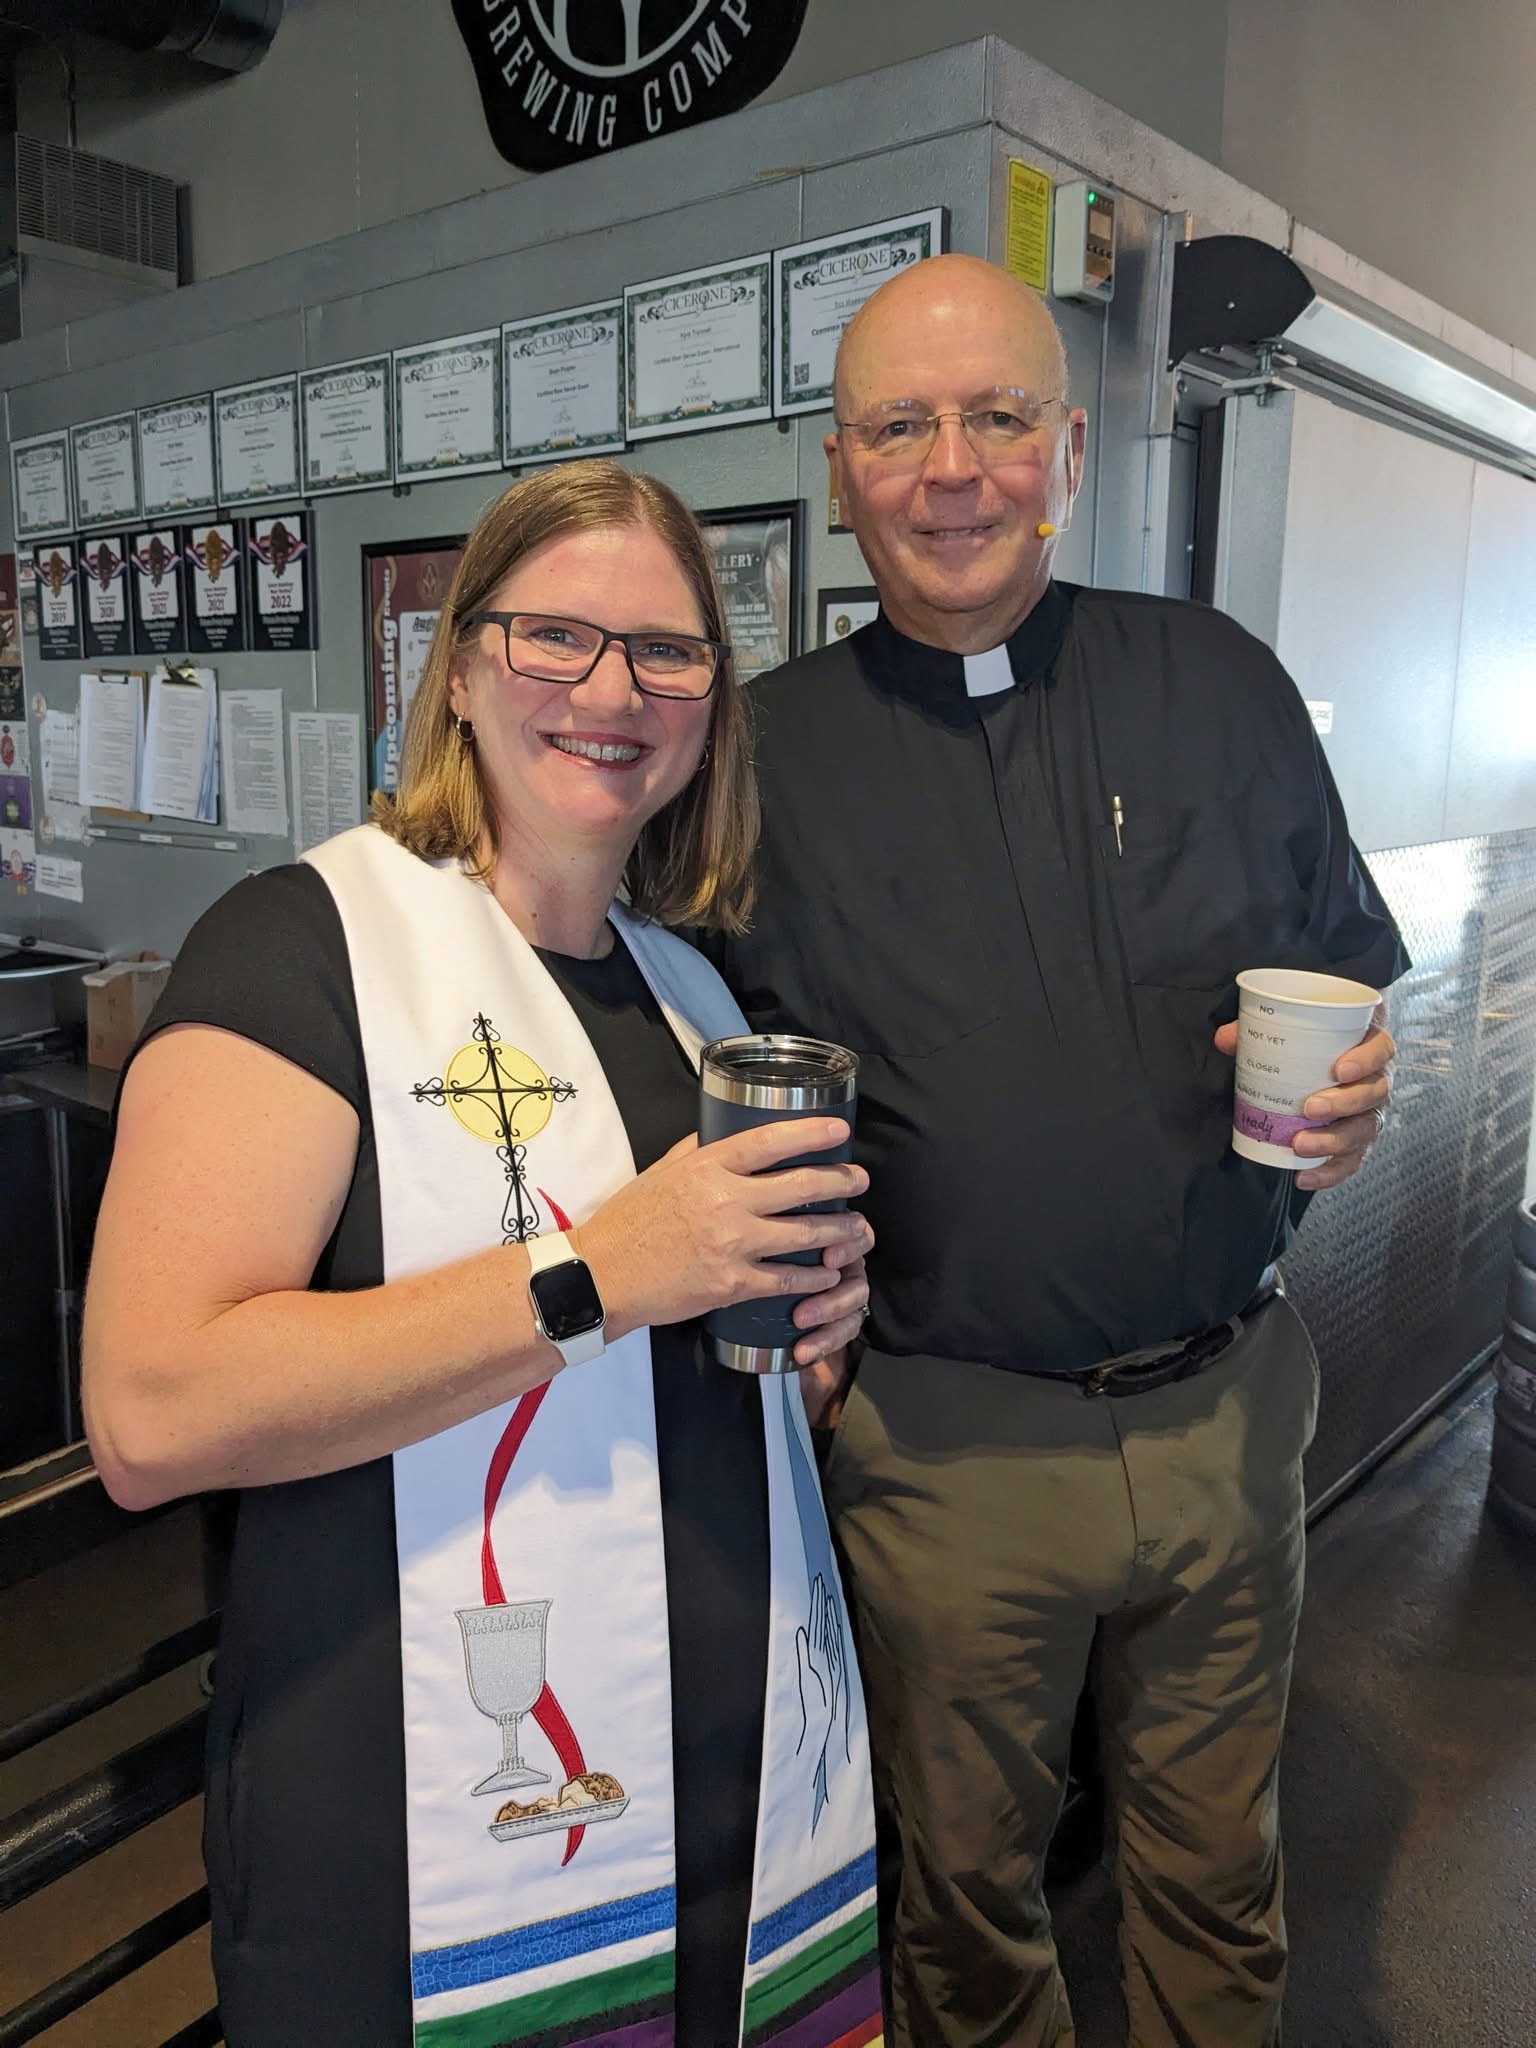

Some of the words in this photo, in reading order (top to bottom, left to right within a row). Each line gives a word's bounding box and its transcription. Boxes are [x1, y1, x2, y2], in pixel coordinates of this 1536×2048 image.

[820, 247, 890, 278] CICERONE
[663, 284, 731, 313] CICERONE
[271, 595, 292, 609] 2022
[383, 568, 391, 616] Events
[381, 618, 398, 785] Upcoming
[1259, 1005, 1275, 1016] NO
[1247, 1028, 1264, 1041] NOT
[1266, 1035, 1288, 1047] YET
[1246, 1058, 1280, 1075] CLOSER
